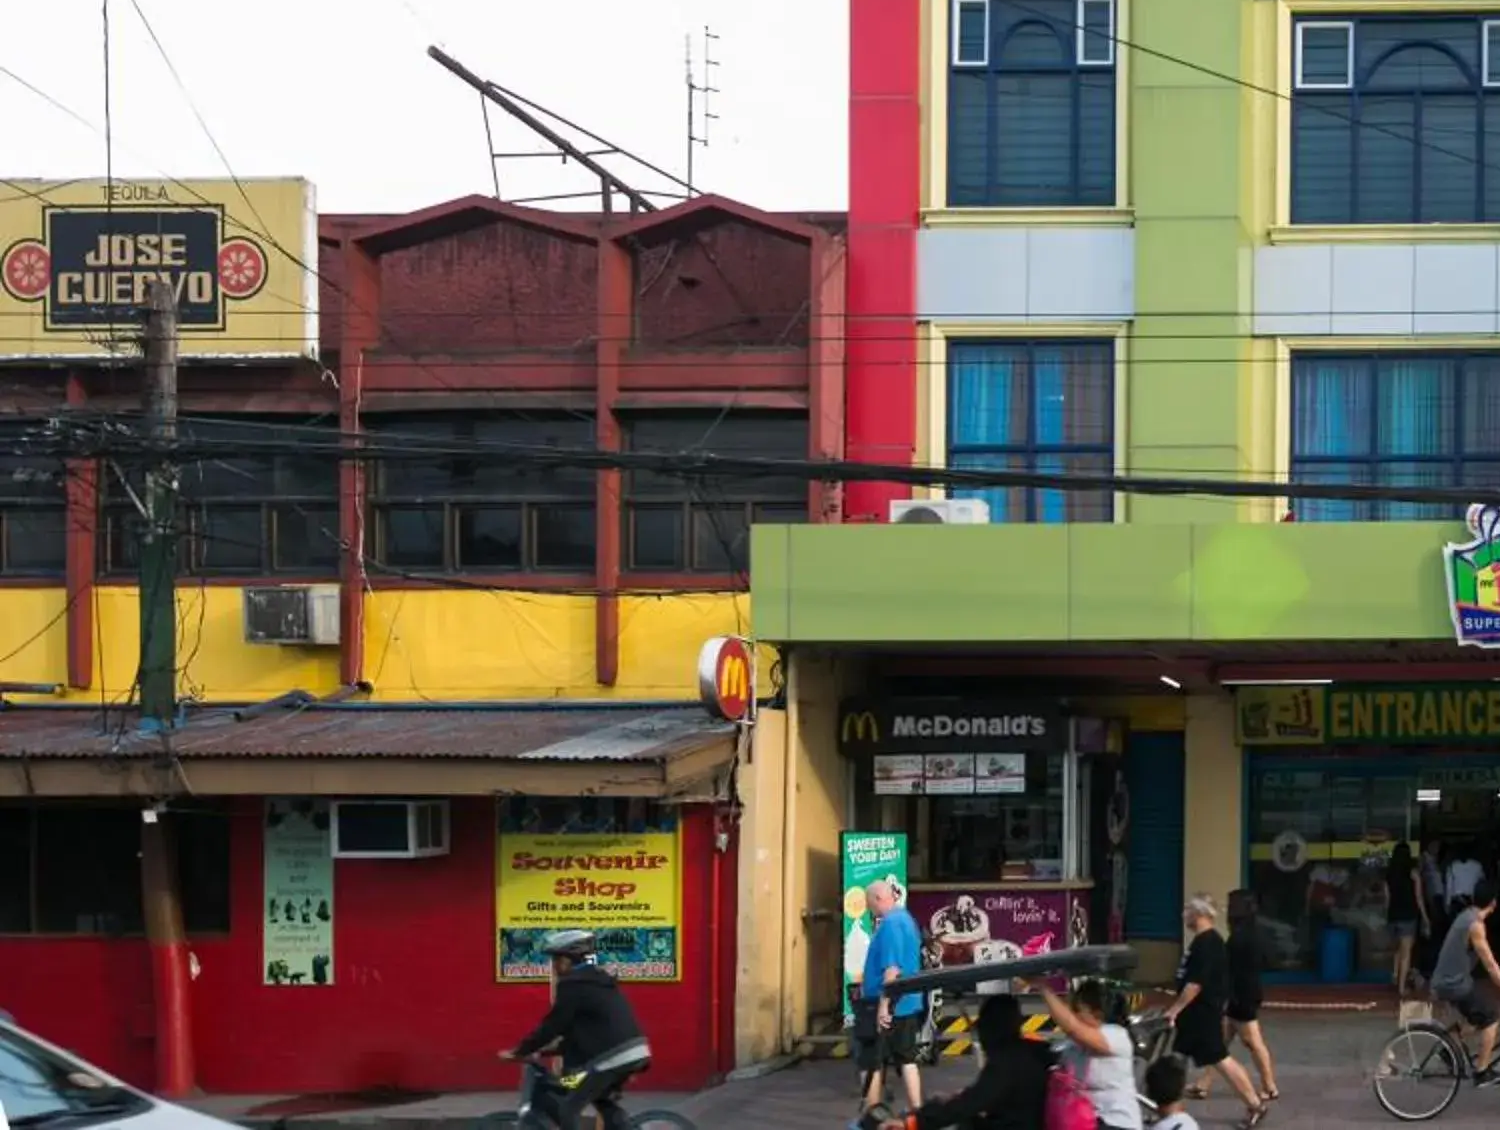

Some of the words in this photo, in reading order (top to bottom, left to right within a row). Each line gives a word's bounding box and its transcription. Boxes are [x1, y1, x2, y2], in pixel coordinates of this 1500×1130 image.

[100, 184, 170, 201] TEQUILA
[84, 233, 188, 267] JOSE
[892, 715, 1046, 738] McDonald's
[847, 837, 896, 853] SWEETEN
[511, 850, 669, 871] Souvenir
[850, 850, 877, 864] YOUR
[553, 877, 637, 900] Shop
[527, 901, 557, 911] Gifts
[561, 901, 585, 911] and
[588, 901, 651, 911] Souvenirs
